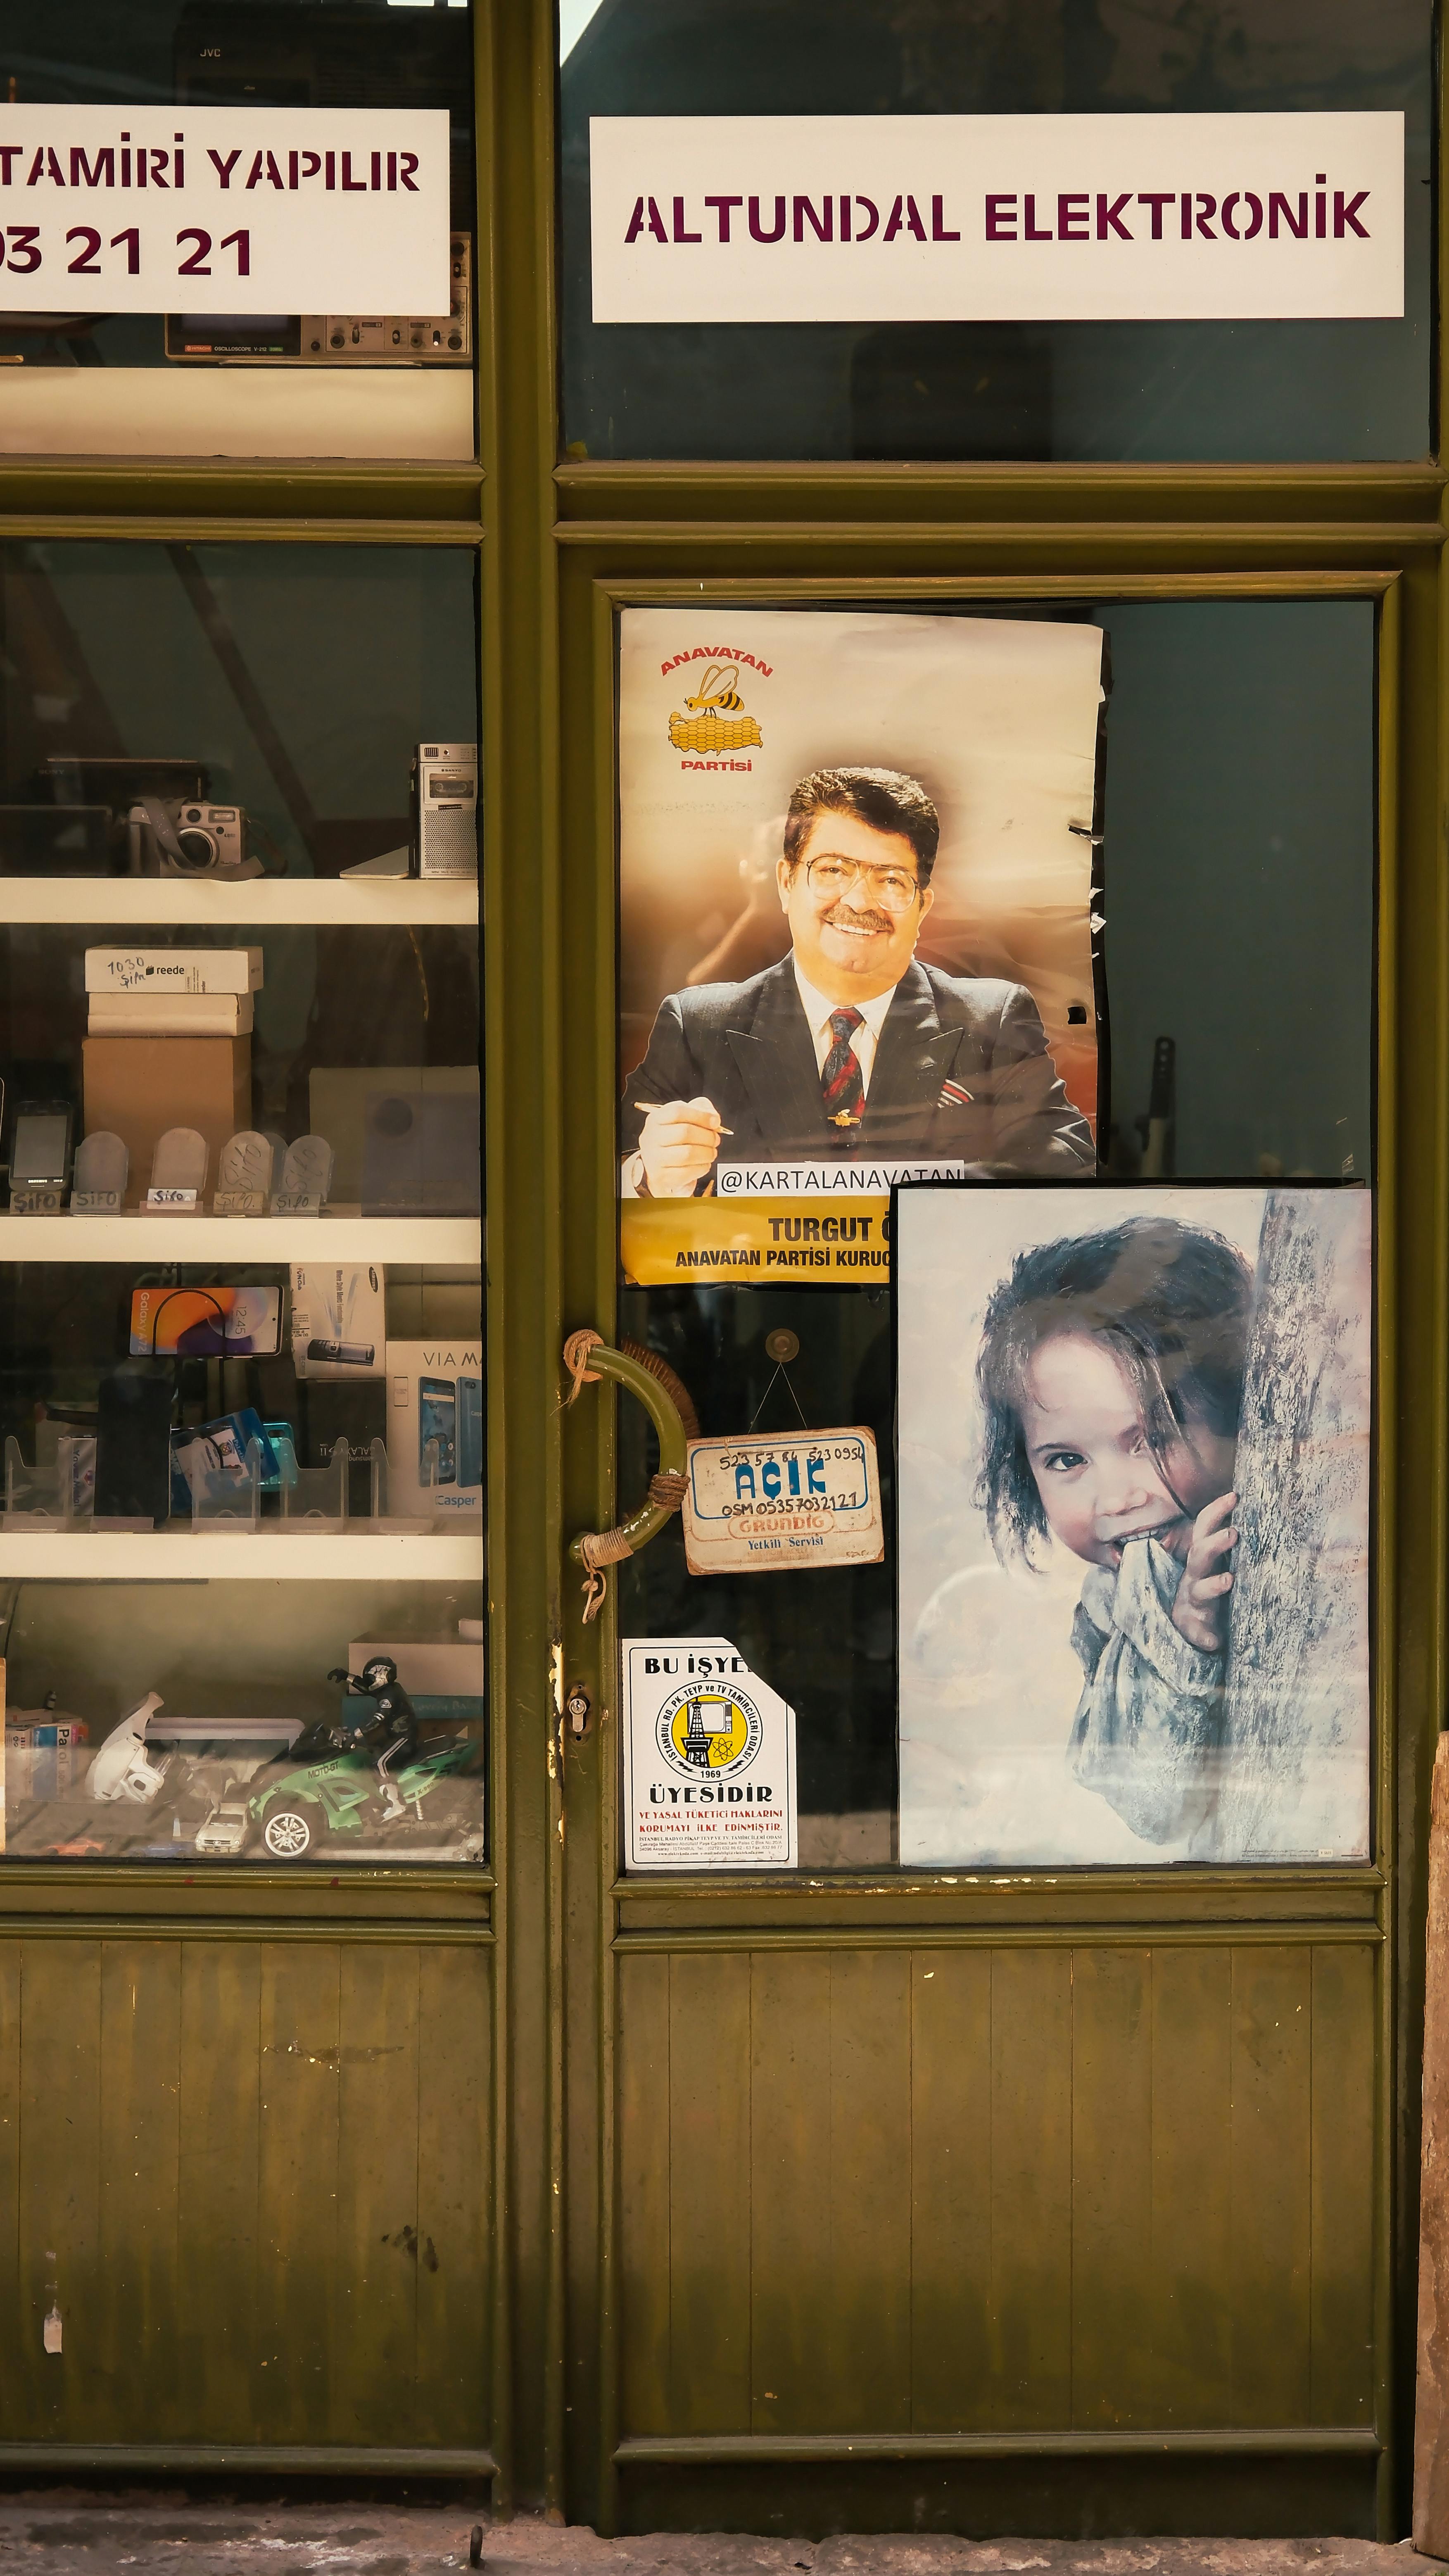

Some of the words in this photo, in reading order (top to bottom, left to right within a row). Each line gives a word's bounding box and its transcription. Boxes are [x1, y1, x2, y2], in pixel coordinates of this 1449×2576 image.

[200, 48, 221, 57] JVC
[0, 132, 184, 188] TAMİRİ
[206, 149, 420, 192] YAPILIR
[624, 194, 961, 245] ALTUNDAL
[985, 173, 1371, 241] ELEKTRONİK
[66, 226, 140, 275] 21
[176, 228, 250, 276] 21
[660, 646, 774, 677] ANAVATAN
[681, 759, 752, 772] PARTİSİ
[721, 1168, 960, 1193] @KARTALANAVATAN
[768, 1217, 873, 1242] TURGUT
[675, 1250, 760, 1267] ANAVATAN
[767, 1247, 831, 1266] PARTİSİ
[137, 1292, 150, 1331] Galaxy
[235, 1306, 247, 1335] 12:45
[138, 1333, 147, 1352] A72
[423, 1352, 456, 1366] VIA
[461, 1352, 482, 1366] M
[720, 1454, 750, 1470] 523
[735, 1458, 826, 1500] AÇIK
[435, 1495, 477, 1509] Casper
[748, 1539, 781, 1551] Yetkili
[789, 1535, 824, 1547] Servisi
[645, 1658, 678, 1674] BU
[688, 1653, 753, 1678] İŞYE
[661, 1723, 678, 1762] İSTANBUL
[683, 1685, 703, 1698] TEYP
[717, 1685, 727, 1694] TV
[727, 1688, 760, 1733] TAMİRCİLERİ
[744, 1735, 758, 1760] ODASI
[307, 1761, 340, 1779] MOTO-GT
[700, 1770, 721, 1778] 1969
[650, 1782, 773, 1804] ÜYESİDİR
[653, 1811, 683, 1819] YASAL
[731, 1810, 783, 1818] HAKLARINI
[639, 1824, 690, 1832] KORUMAYI
